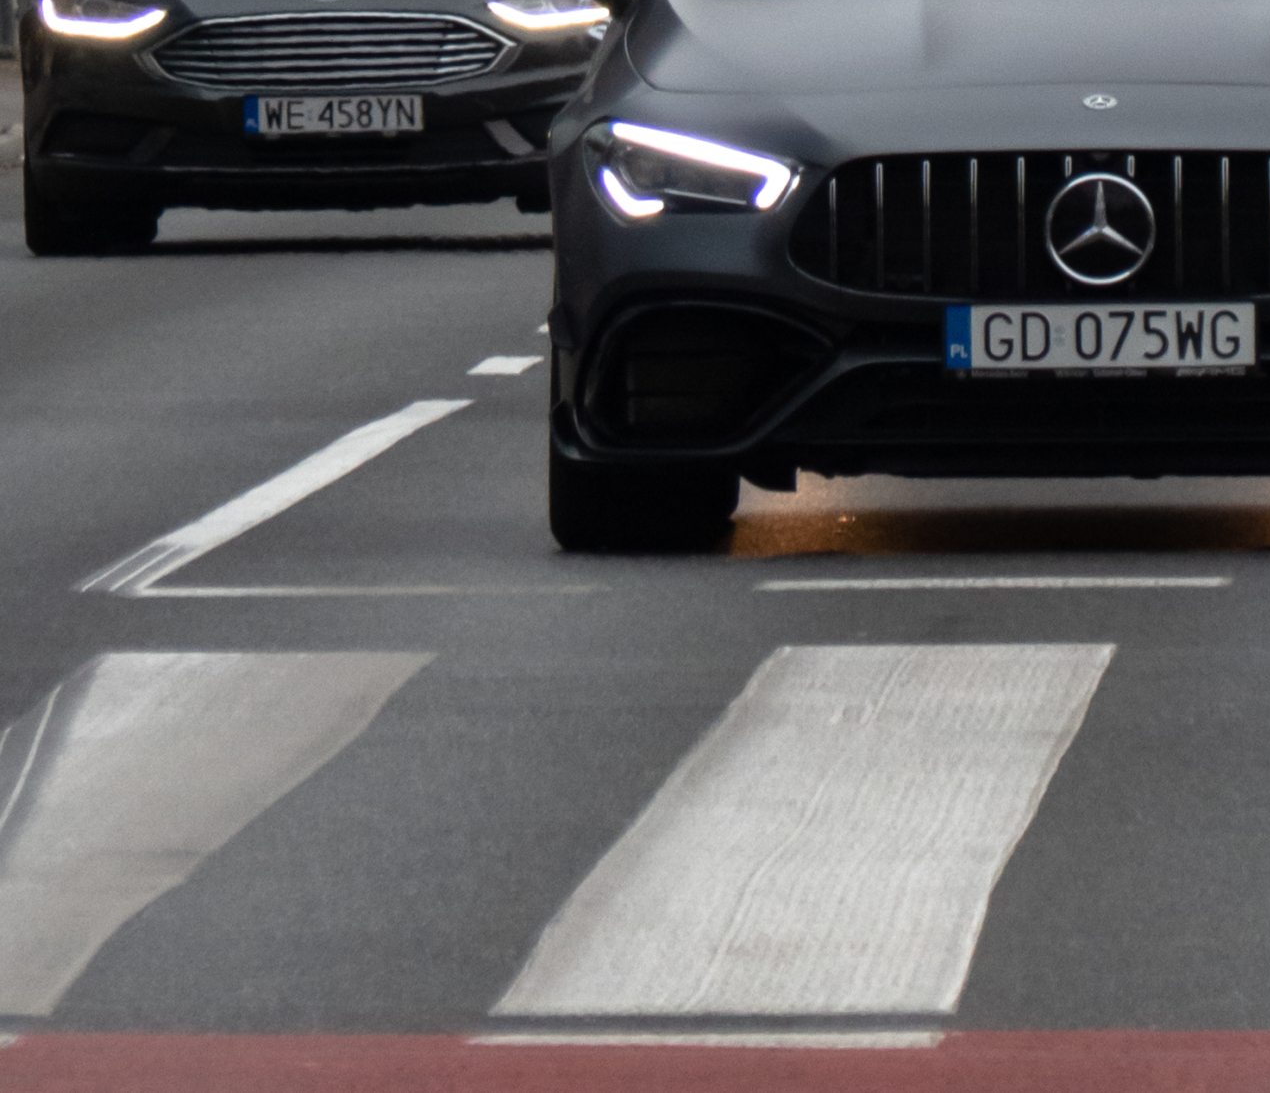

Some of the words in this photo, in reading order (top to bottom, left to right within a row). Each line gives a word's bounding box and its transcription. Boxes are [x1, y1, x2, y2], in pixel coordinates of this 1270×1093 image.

[264, 100, 305, 130] WE
[318, 98, 416, 129] 458YN
[950, 344, 968, 359] PL
[983, 311, 1051, 362] GD
[1074, 309, 1242, 362] 075WG
